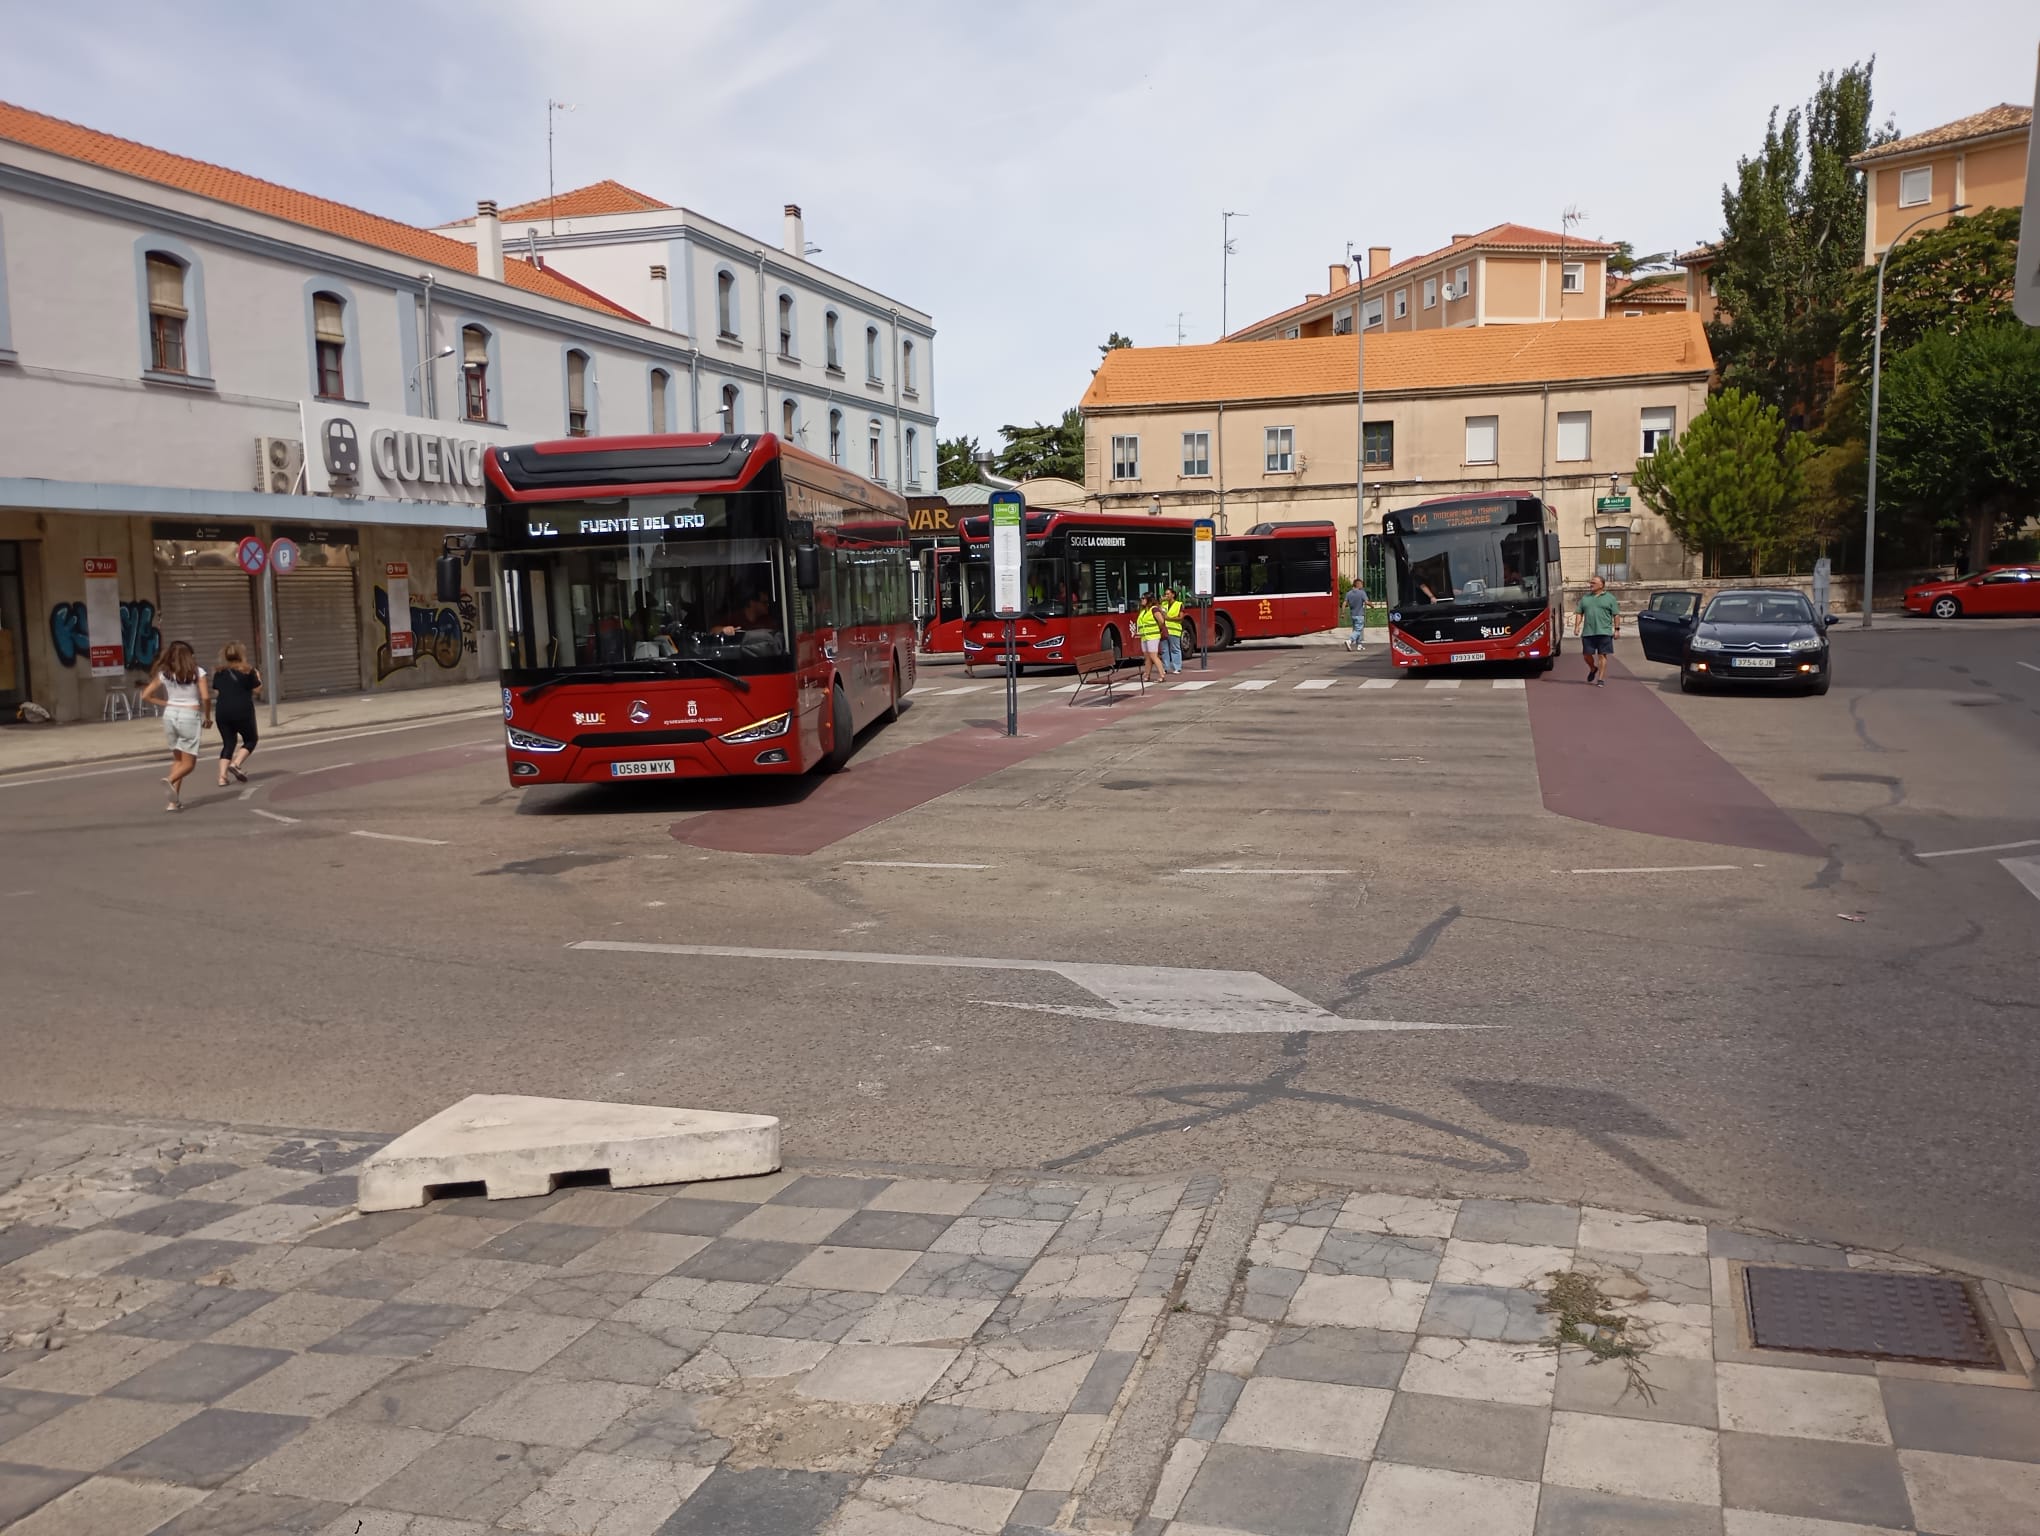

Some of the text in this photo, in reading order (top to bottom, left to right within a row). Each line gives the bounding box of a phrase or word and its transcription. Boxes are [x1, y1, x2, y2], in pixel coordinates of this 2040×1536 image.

[371, 428, 485, 487] CUENC
[580, 518, 639, 534] FUENTE
[643, 516, 670, 531] DEL
[674, 514, 705, 529] ORO
[1412, 514, 1428, 530] 04
[1070, 536, 1126, 547] SIGUE LA CORRIENTE
[1492, 626, 1512, 636] LUC
[585, 712, 606, 723] LUC
[619, 761, 671, 775] 0589 MYK
